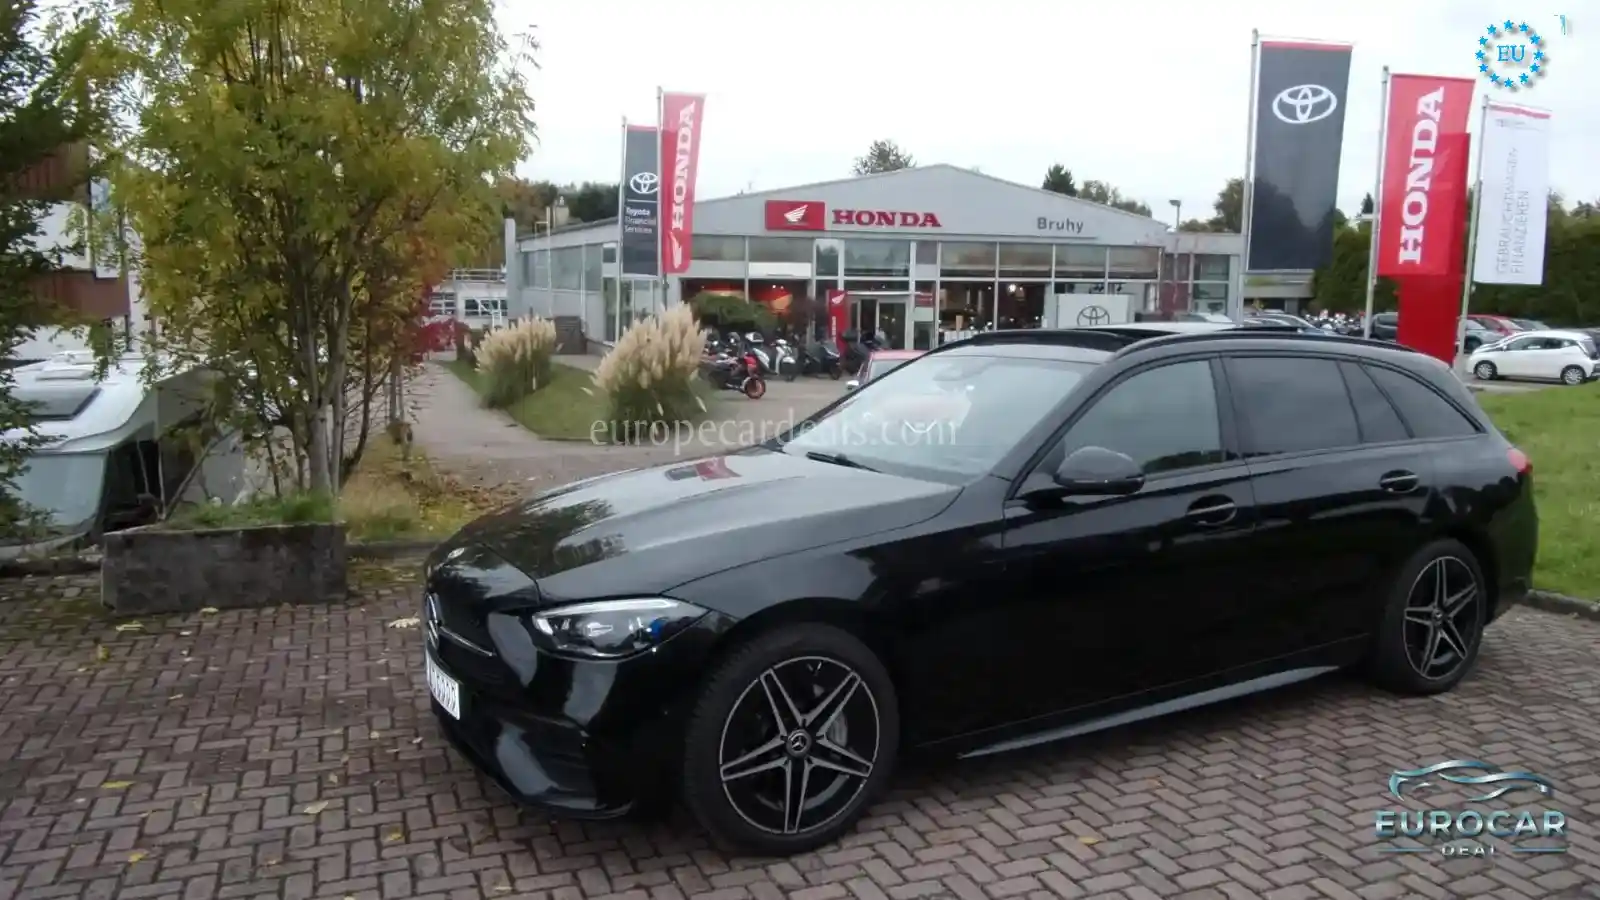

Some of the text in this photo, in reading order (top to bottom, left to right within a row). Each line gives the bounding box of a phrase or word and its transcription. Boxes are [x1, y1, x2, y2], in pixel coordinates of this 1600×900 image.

[671, 100, 696, 231] HONDA
[1399, 87, 1444, 264] HONDA
[626, 206, 650, 217] Toyota
[832, 209, 942, 227] HONDA
[1037, 217, 1084, 234] Bruhy
